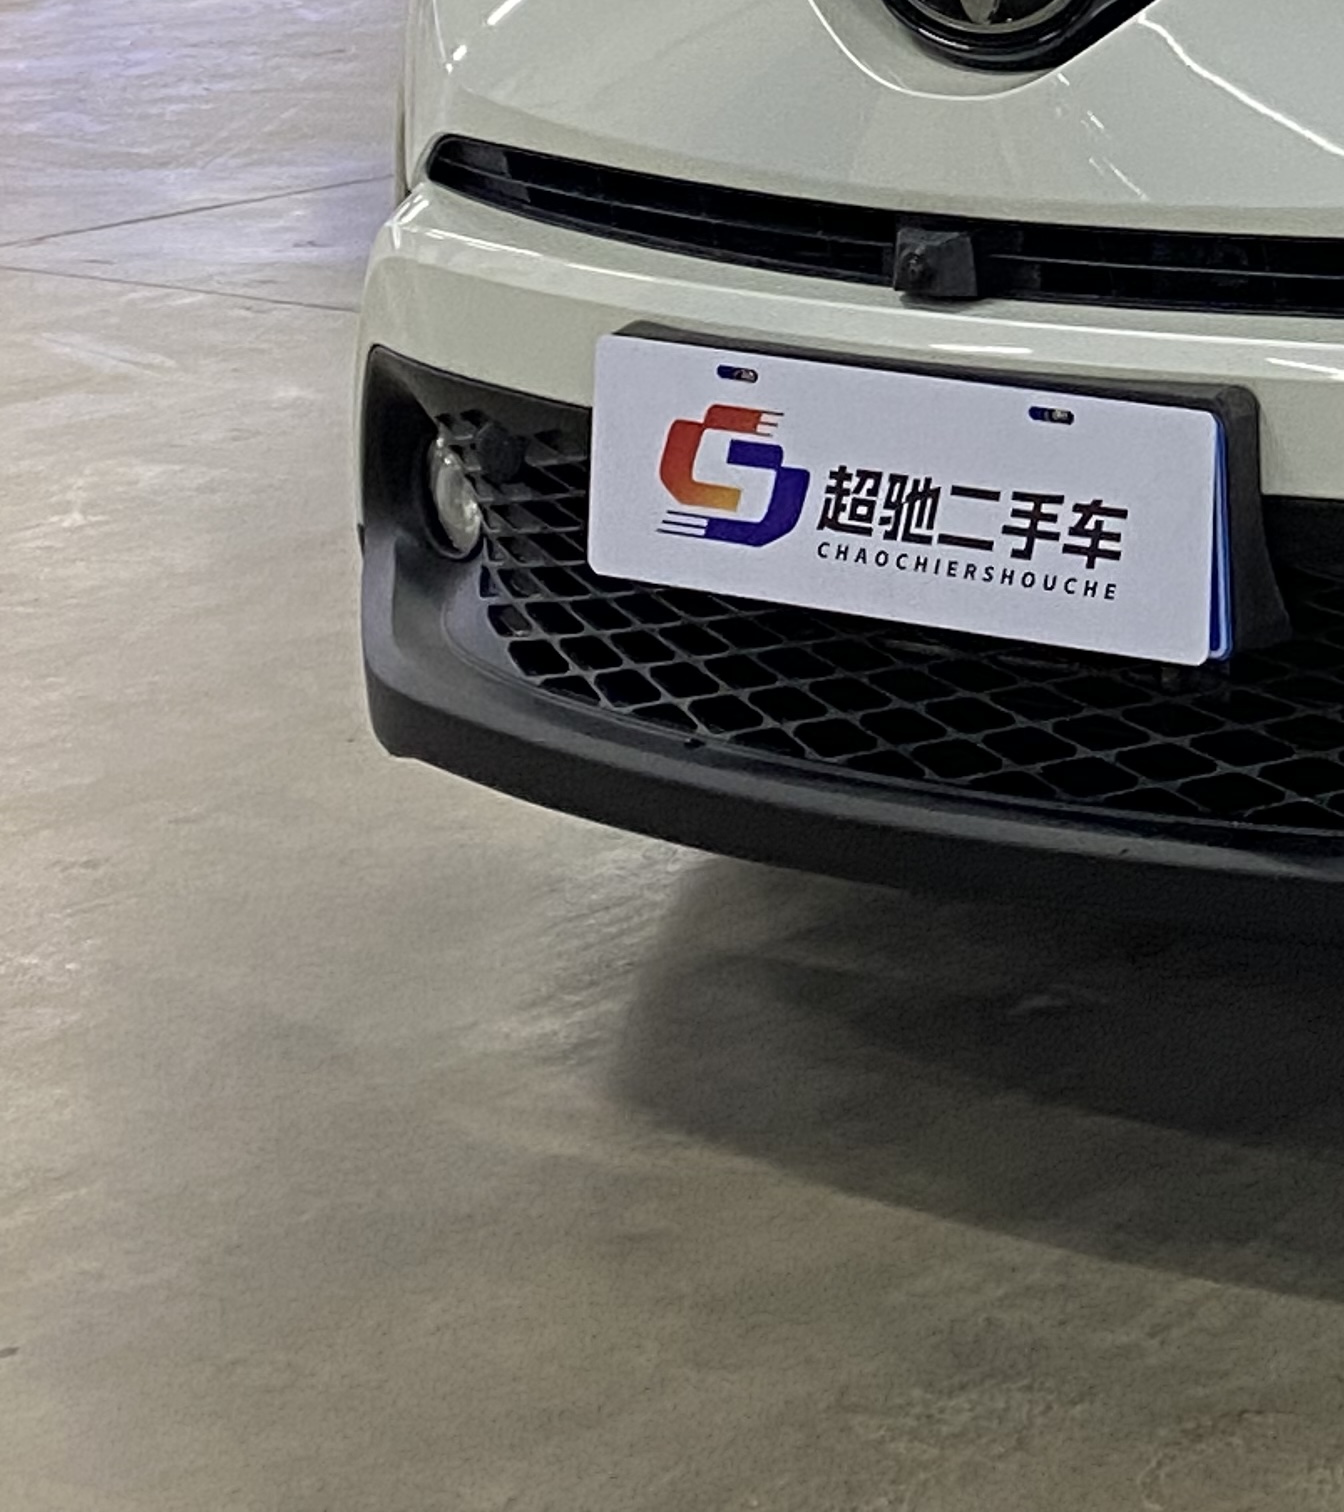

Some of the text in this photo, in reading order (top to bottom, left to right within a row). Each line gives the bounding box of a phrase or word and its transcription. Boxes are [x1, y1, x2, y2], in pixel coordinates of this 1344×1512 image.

[816, 464, 1130, 570] 超驰二手车
[816, 541, 1118, 601] CHAOCHIERSHOUCHE
